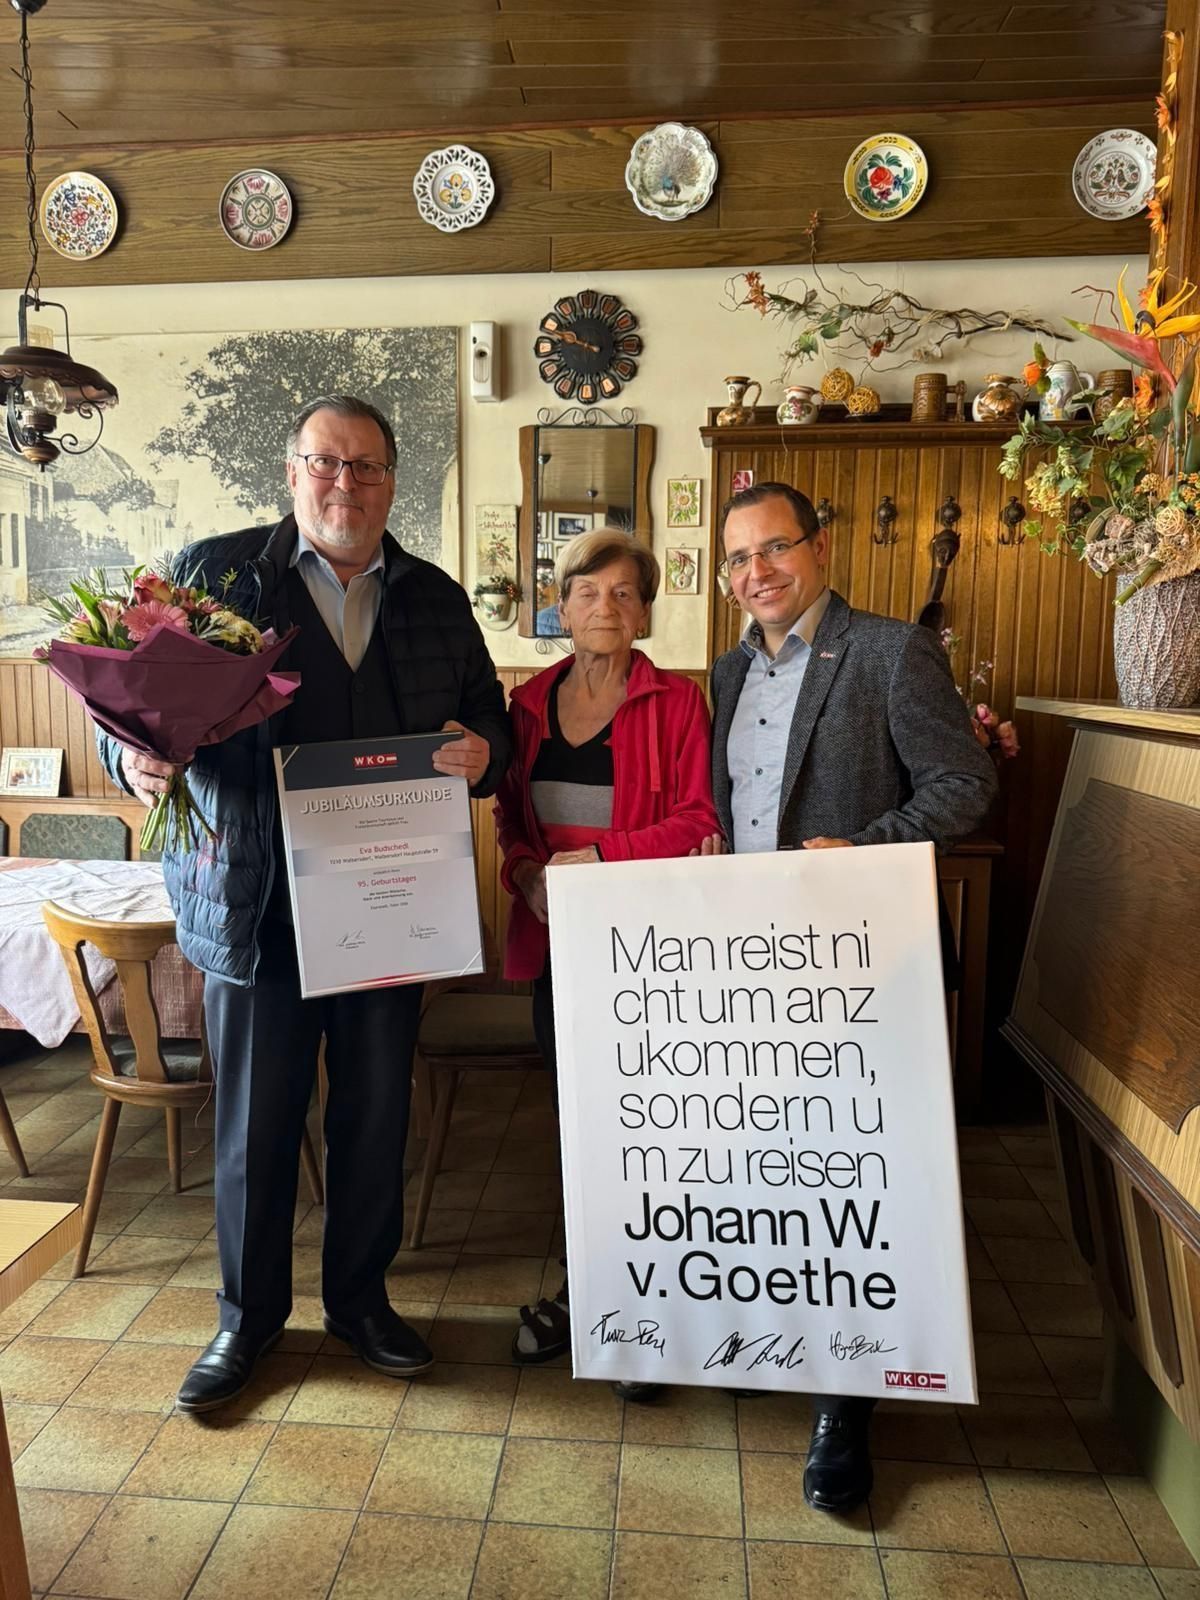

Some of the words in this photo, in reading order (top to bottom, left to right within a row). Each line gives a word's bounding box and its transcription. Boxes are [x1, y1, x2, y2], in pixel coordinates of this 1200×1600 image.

[355, 755, 385, 767] WKO
[300, 787, 453, 815] JUBILÄUMSURKUNDE
[359, 847, 373, 855] Eva
[357, 880, 369, 888] 95.
[371, 875, 417, 887] Geburtstages
[611, 925, 716, 974] Man
[727, 922, 823, 971] reist
[831, 919, 871, 970] ni
[613, 977, 688, 1025] cht
[698, 987, 775, 1024] um
[786, 986, 879, 1024] anz
[617, 1029, 876, 1087] ukommen,
[619, 1081, 834, 1133] sondern
[852, 1097, 884, 1135] u
[622, 1146, 667, 1182] m
[678, 1147, 733, 1185] zu
[745, 1137, 888, 1190] reisen
[624, 1191, 811, 1247] Johann
[818, 1197, 890, 1251] W.
[626, 1261, 668, 1298] v.
[678, 1250, 897, 1311] Goethe
[886, 1372, 929, 1387] WKO
